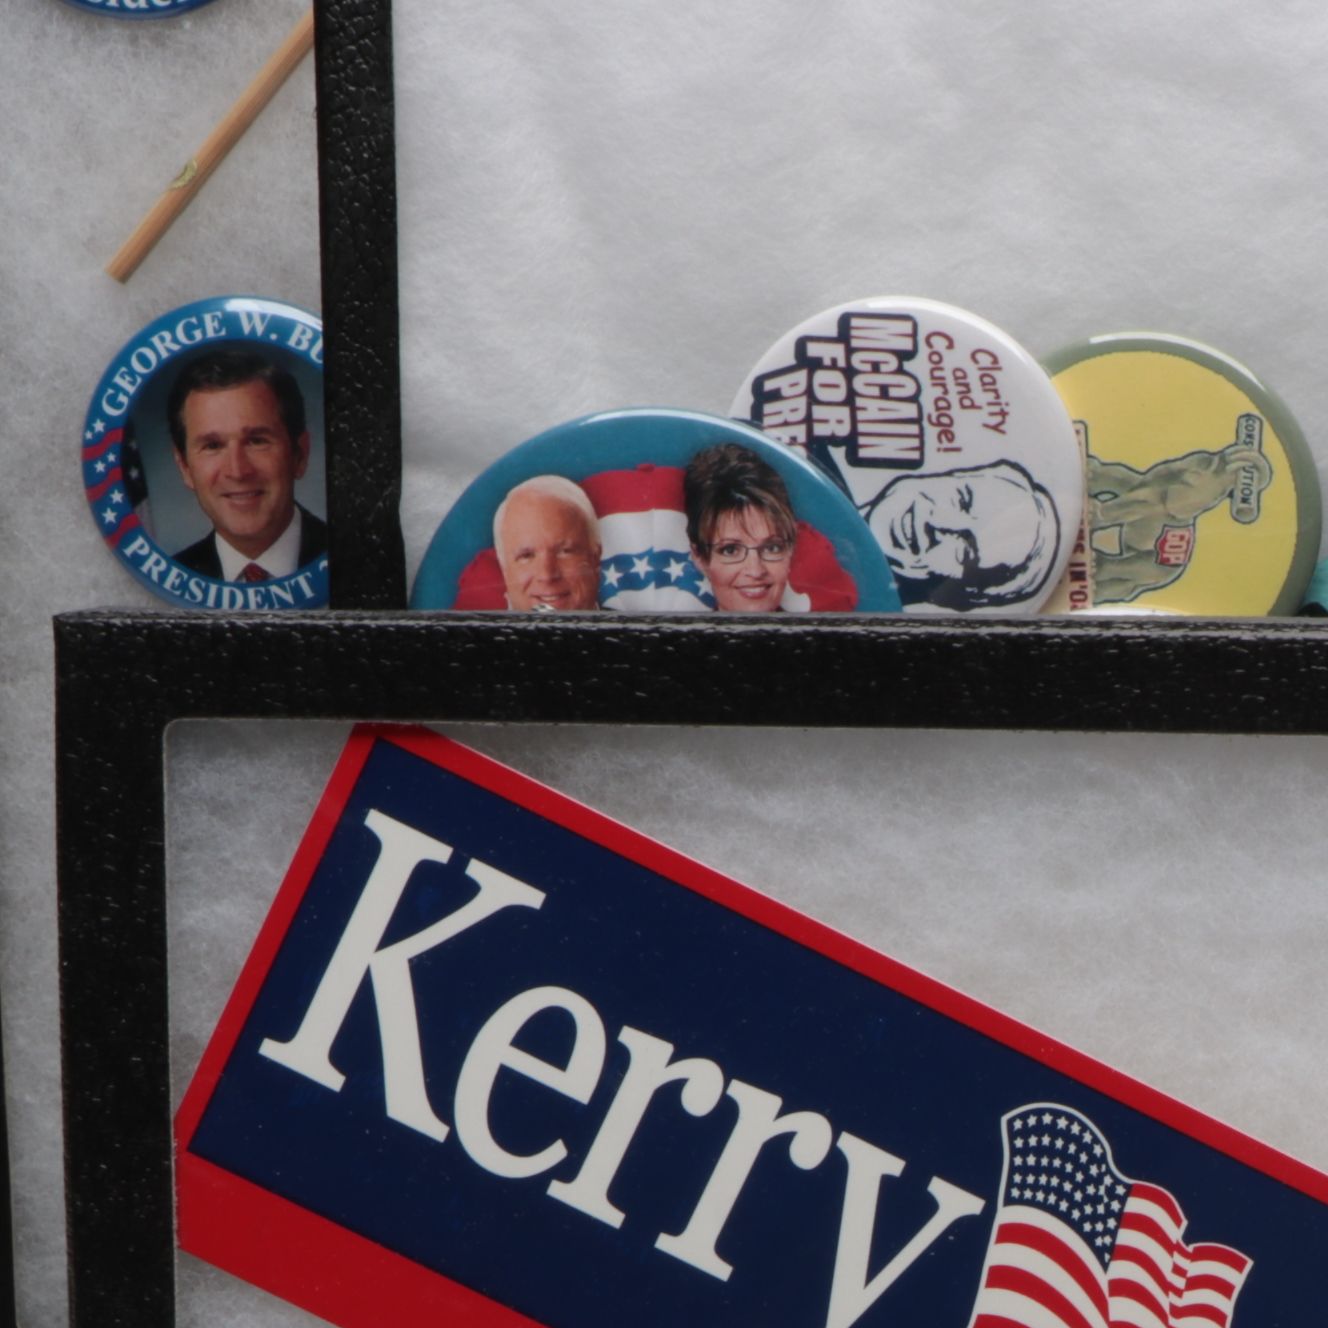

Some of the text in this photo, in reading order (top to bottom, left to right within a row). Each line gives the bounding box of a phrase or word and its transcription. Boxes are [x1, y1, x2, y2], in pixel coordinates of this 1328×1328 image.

[102, 310, 323, 417] GEORGE W. BU
[800, 337, 851, 442] FOR
[924, 330, 963, 456] Courage!
[951, 367, 984, 411] and
[970, 348, 1011, 436] Clarity
[757, 365, 808, 458] PRE
[1240, 417, 1257, 506] CONSUTION
[123, 535, 317, 609] PRESIDENT
